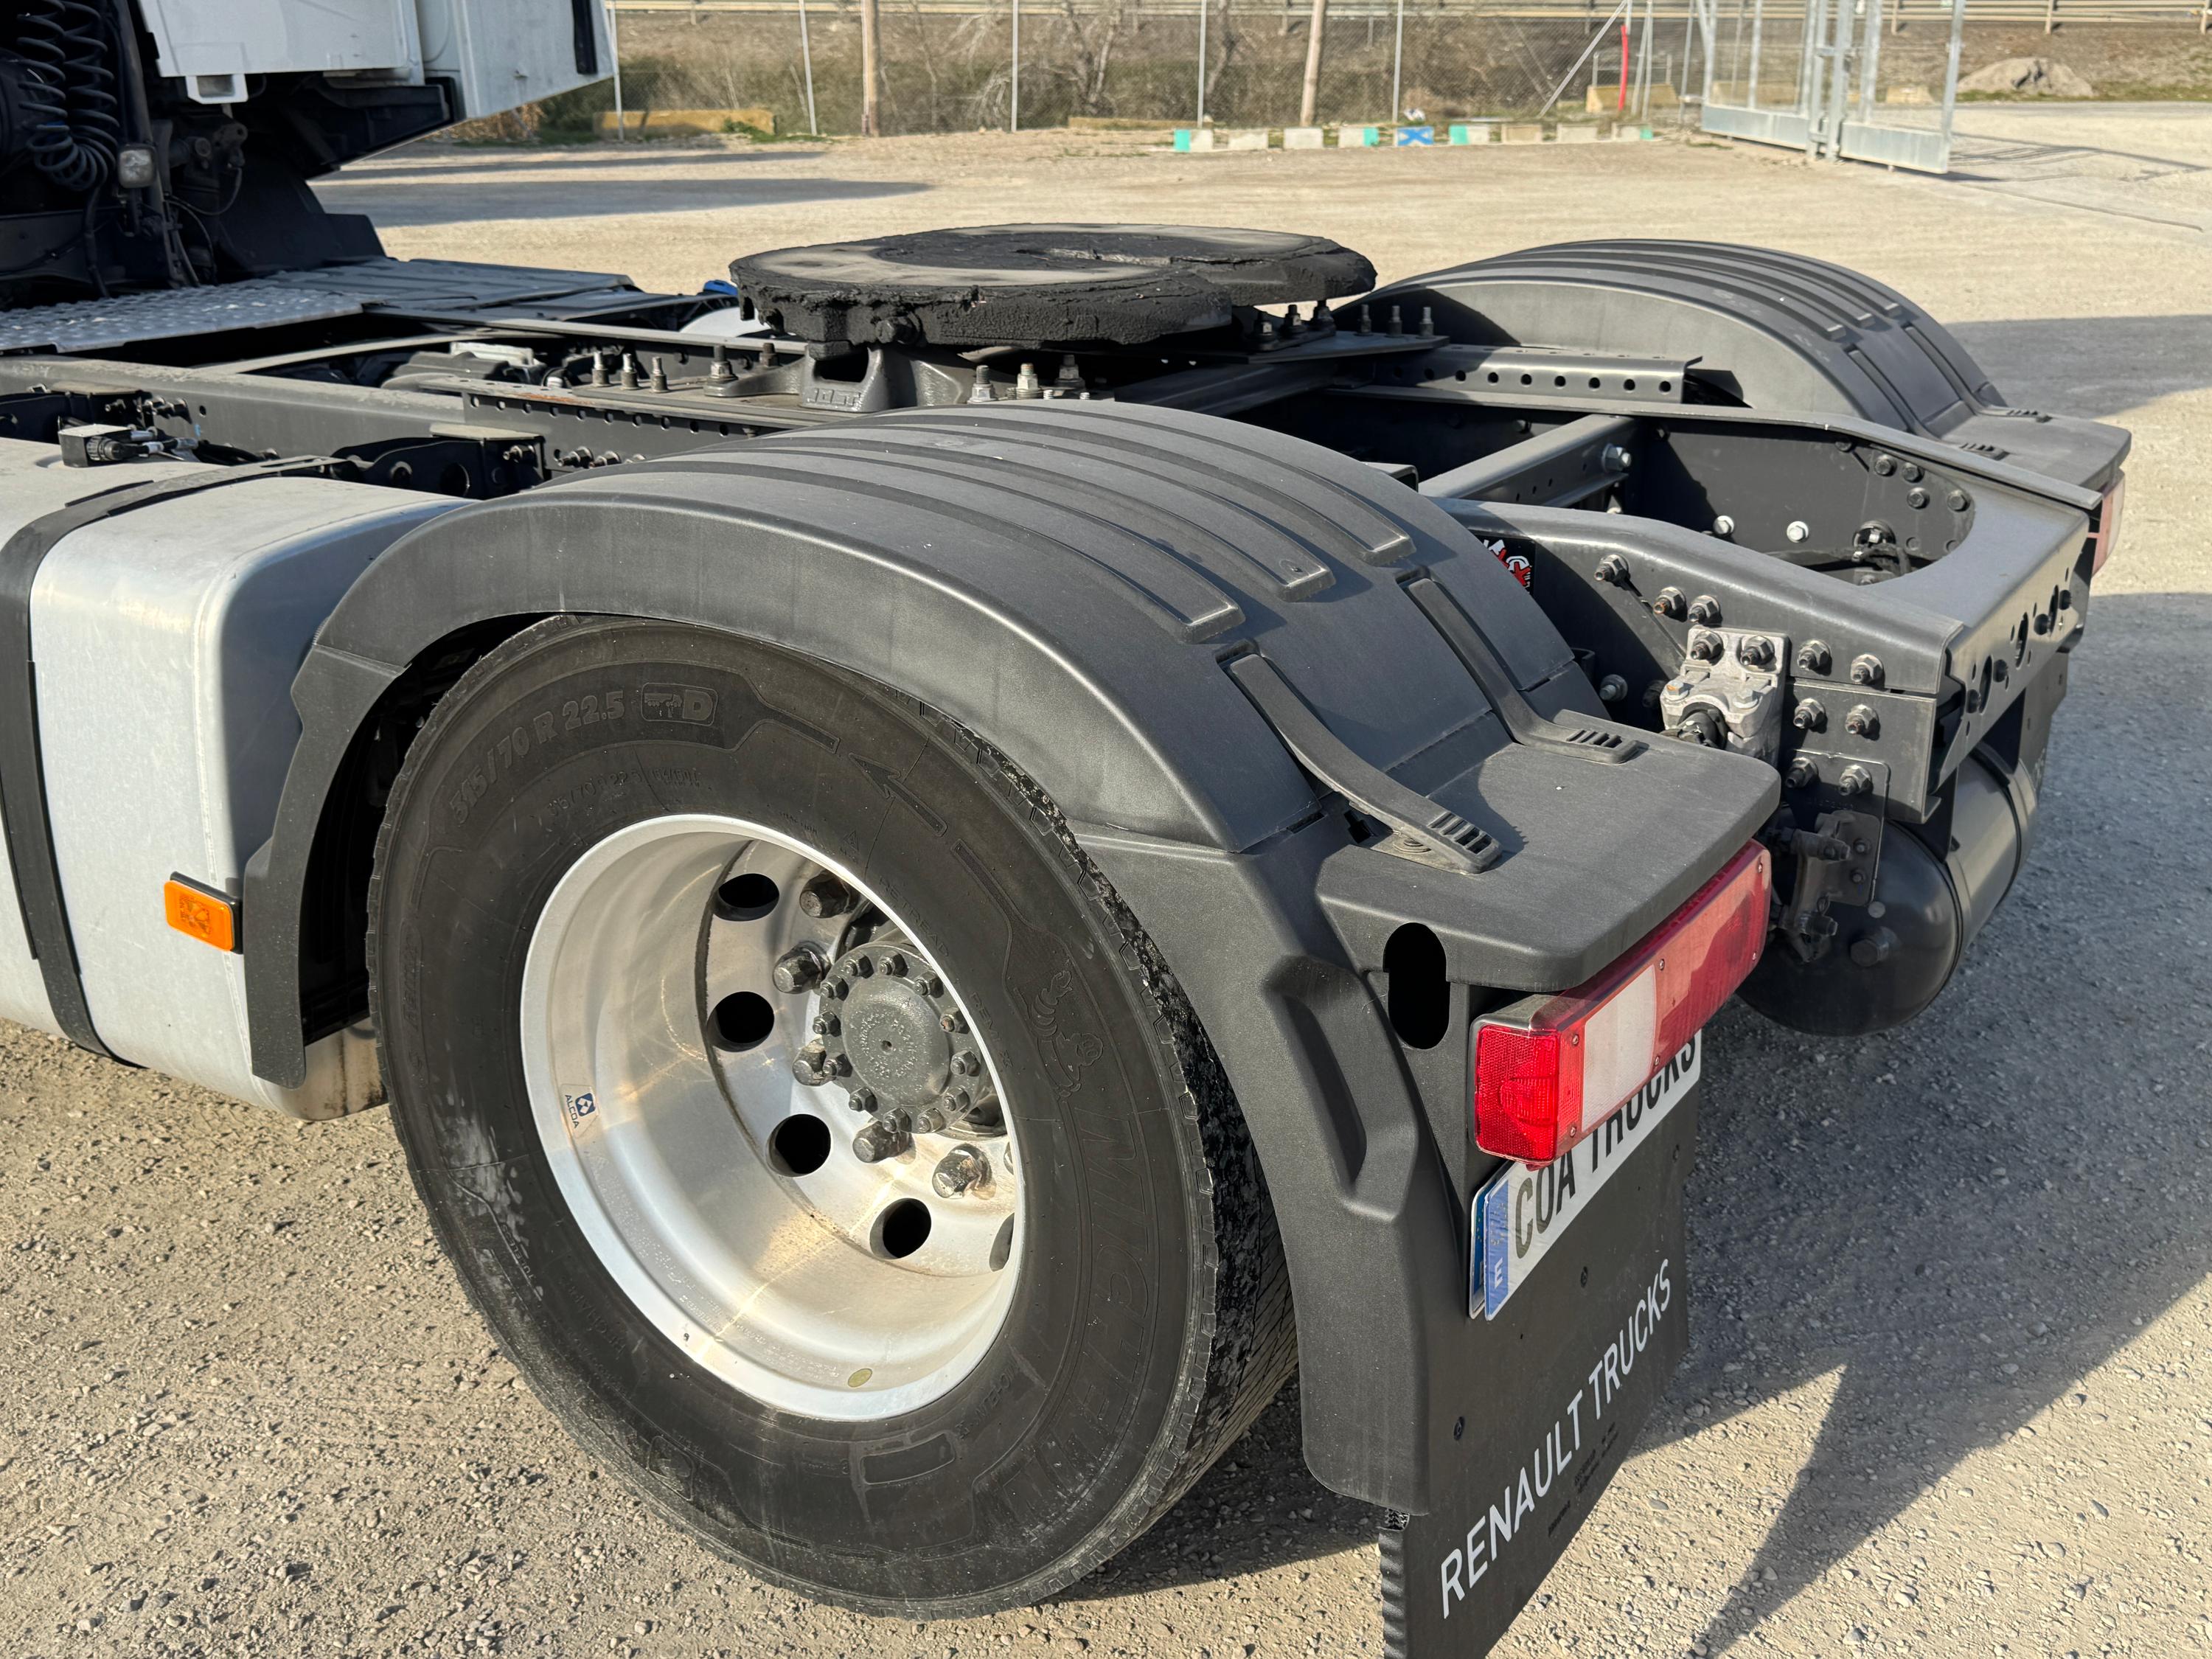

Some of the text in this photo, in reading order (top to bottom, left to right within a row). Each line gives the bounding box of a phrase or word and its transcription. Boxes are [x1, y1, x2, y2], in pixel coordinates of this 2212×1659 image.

[533, 711, 558, 744] R
[563, 690, 625, 731] 22.5
[879, 875, 950, 957] RETREAD
[565, 1094, 580, 1129] ALCOA
[1515, 1148, 1576, 1259] COA
[1495, 1256, 1503, 1290] E
[1441, 1389, 1583, 1620] RENAULT
[1588, 1259, 1670, 1420] TRUCKS
